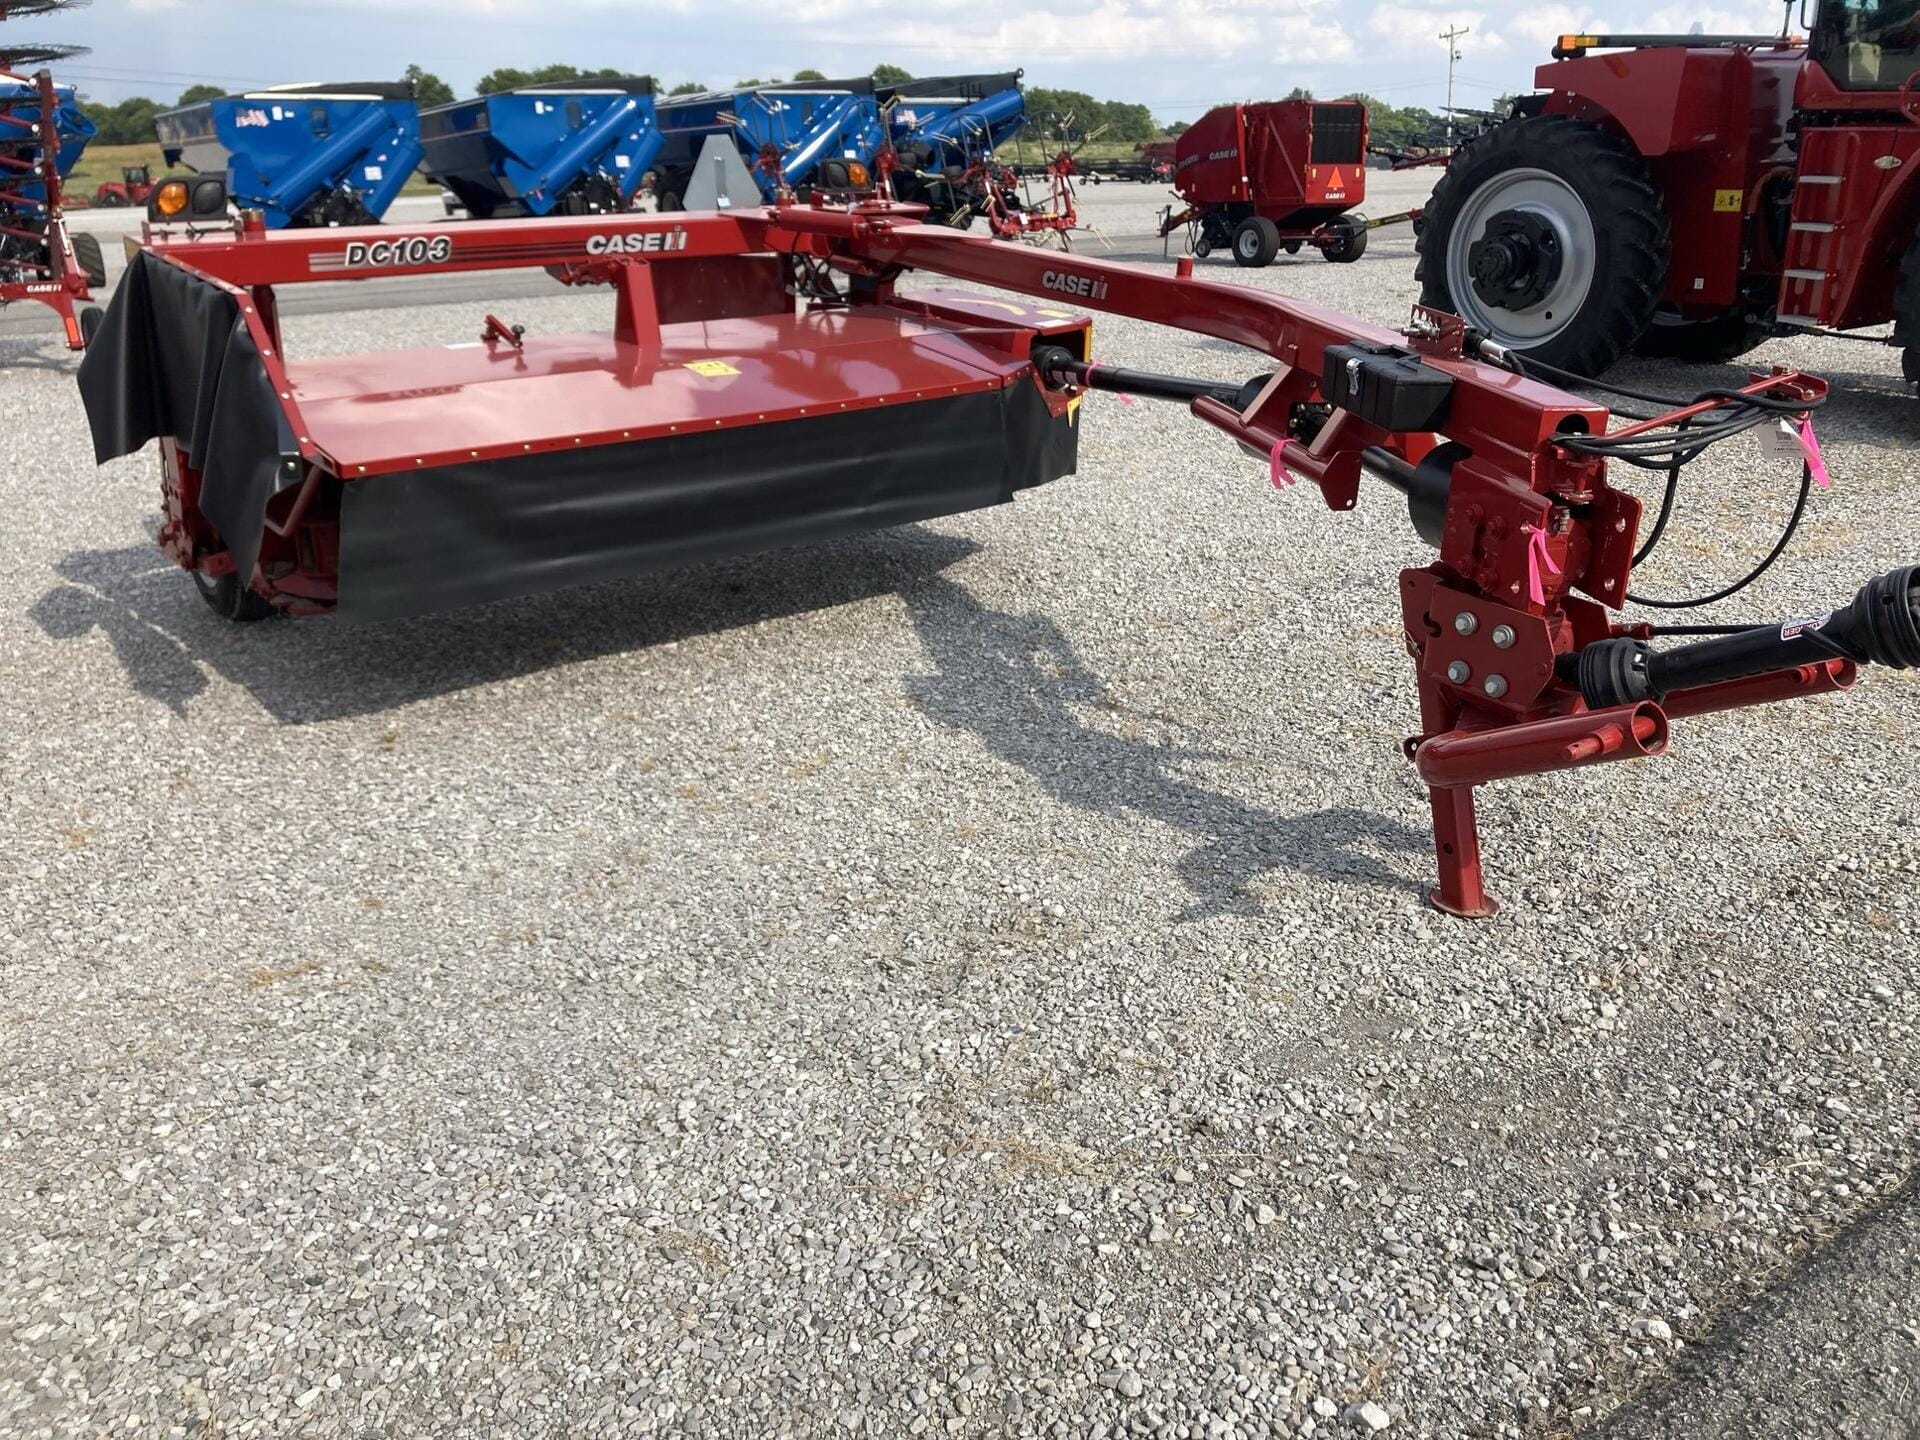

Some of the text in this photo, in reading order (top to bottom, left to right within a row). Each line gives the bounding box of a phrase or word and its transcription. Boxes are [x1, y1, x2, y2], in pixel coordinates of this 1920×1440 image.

[344, 235, 452, 267] DC103
[586, 233, 662, 255] CASE
[1042, 270, 1091, 297] CASE
